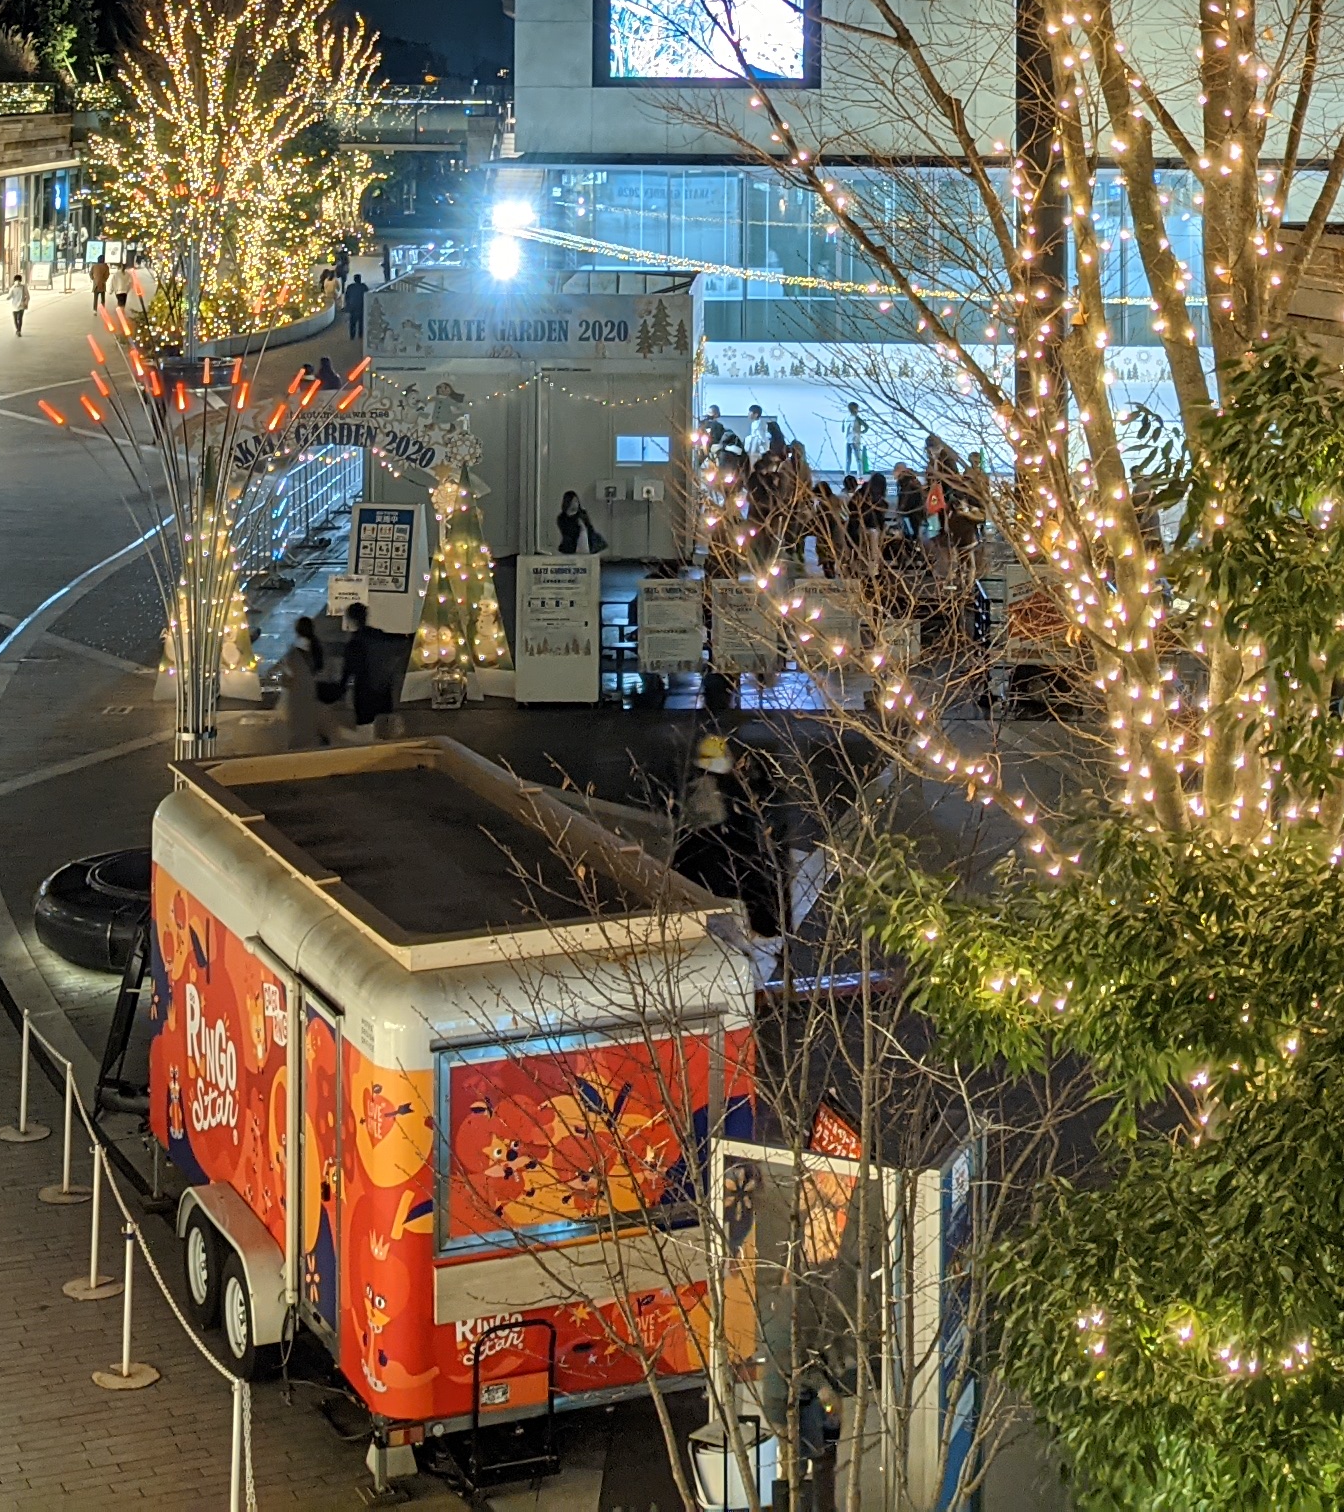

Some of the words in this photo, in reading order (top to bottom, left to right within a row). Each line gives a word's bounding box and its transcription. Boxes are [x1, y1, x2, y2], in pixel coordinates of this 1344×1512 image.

[427, 318, 486, 342] SKATE
[492, 318, 569, 343] GARDEN
[578, 319, 629, 342] 2020
[295, 422, 379, 448] GARDEN
[386, 430, 436, 469] 2020
[186, 983, 237, 1091] RINGO
